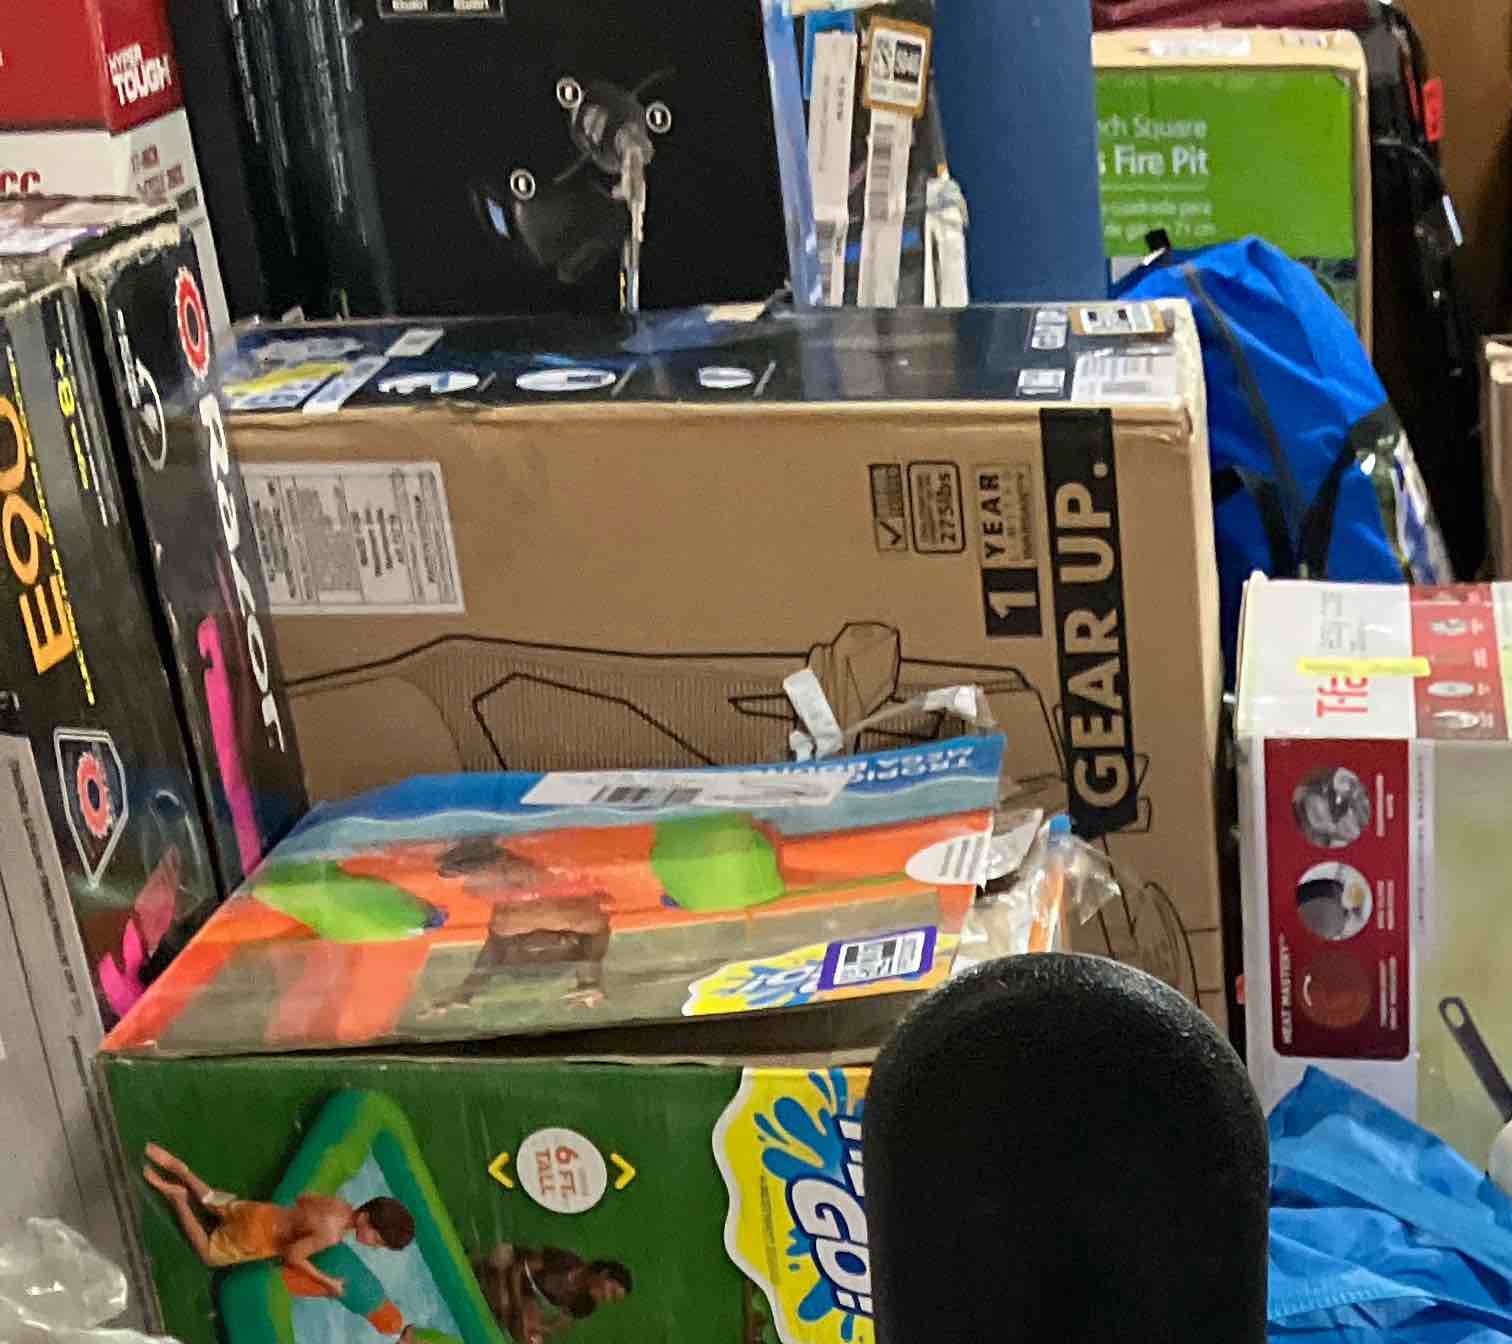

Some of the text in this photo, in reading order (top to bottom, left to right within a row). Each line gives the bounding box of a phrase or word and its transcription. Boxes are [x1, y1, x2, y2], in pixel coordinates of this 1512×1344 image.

[112, 54, 172, 106] TOUGH
[1133, 116, 1207, 142] Square
[1114, 144, 1210, 177] Fire Pit
[978, 473, 1006, 559] YEAR
[988, 590, 1038, 622] 1
[1055, 461, 1131, 808] GEAR UP.
[1316, 672, 1369, 718] T-fa
[533, 1147, 556, 1197] TALL
[555, 1145, 579, 1163] 6
